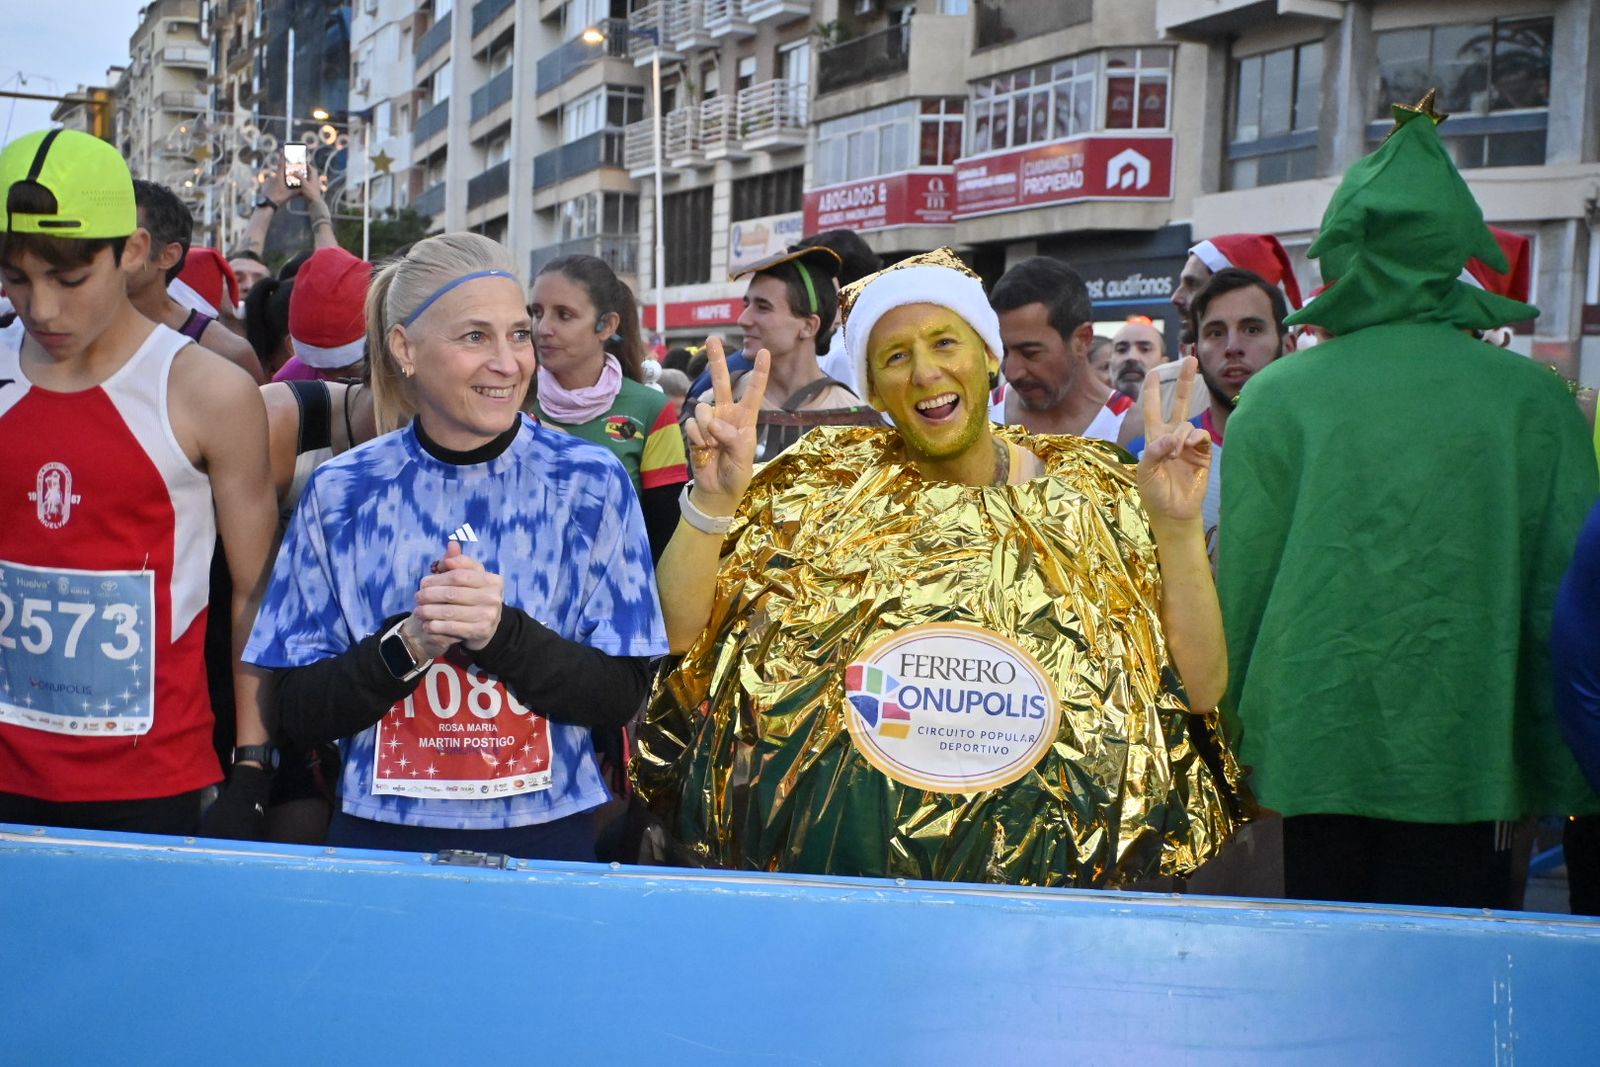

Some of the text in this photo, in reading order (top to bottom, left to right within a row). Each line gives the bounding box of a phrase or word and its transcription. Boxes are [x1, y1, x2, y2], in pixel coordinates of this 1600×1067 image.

[1023, 169, 1084, 196] PROPIEDAD
[818, 181, 887, 213] ABOGADOS &
[697, 303, 731, 320] MAPFRE
[0, 590, 140, 661] 2573
[899, 653, 1016, 685] FERRERO
[898, 685, 1046, 719] ONUPOLIS
[438, 723, 498, 732] ROSA MARIA
[917, 725, 1035, 743] CIRCUITO POPULAR
[418, 735, 515, 748] MARTIN POSTIGO
[939, 741, 1010, 755] DEPORTIVO
